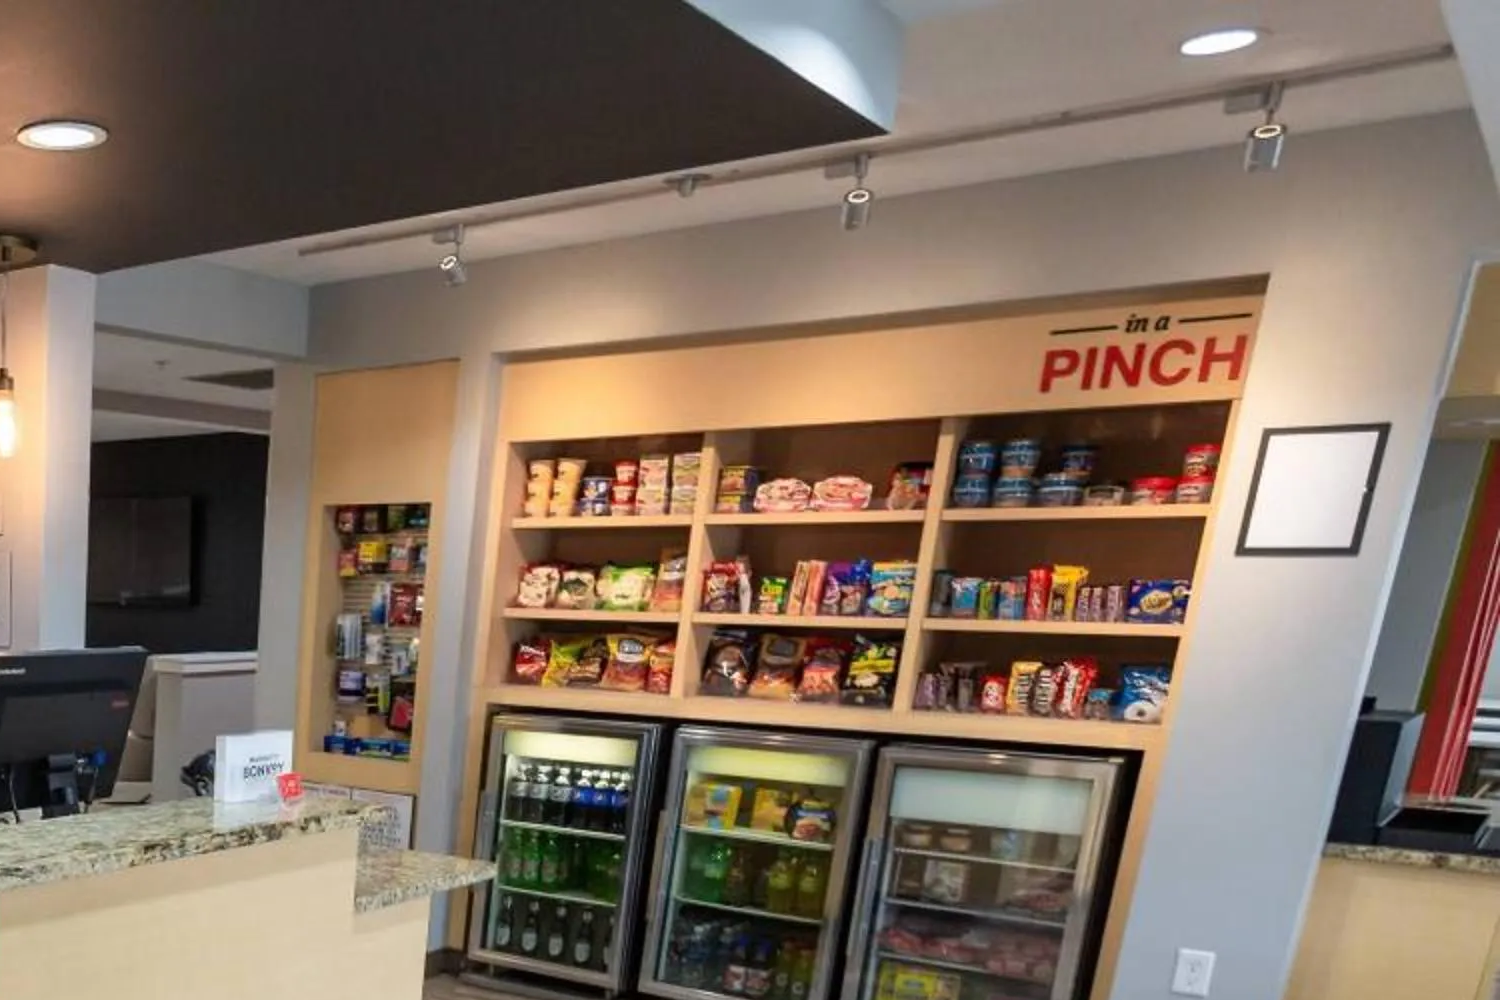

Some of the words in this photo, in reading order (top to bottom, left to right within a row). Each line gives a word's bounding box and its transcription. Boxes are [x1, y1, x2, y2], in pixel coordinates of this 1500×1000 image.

[1125, 314, 1149, 333] in
[1154, 315, 1171, 331] a
[1039, 335, 1248, 393] PINCH
